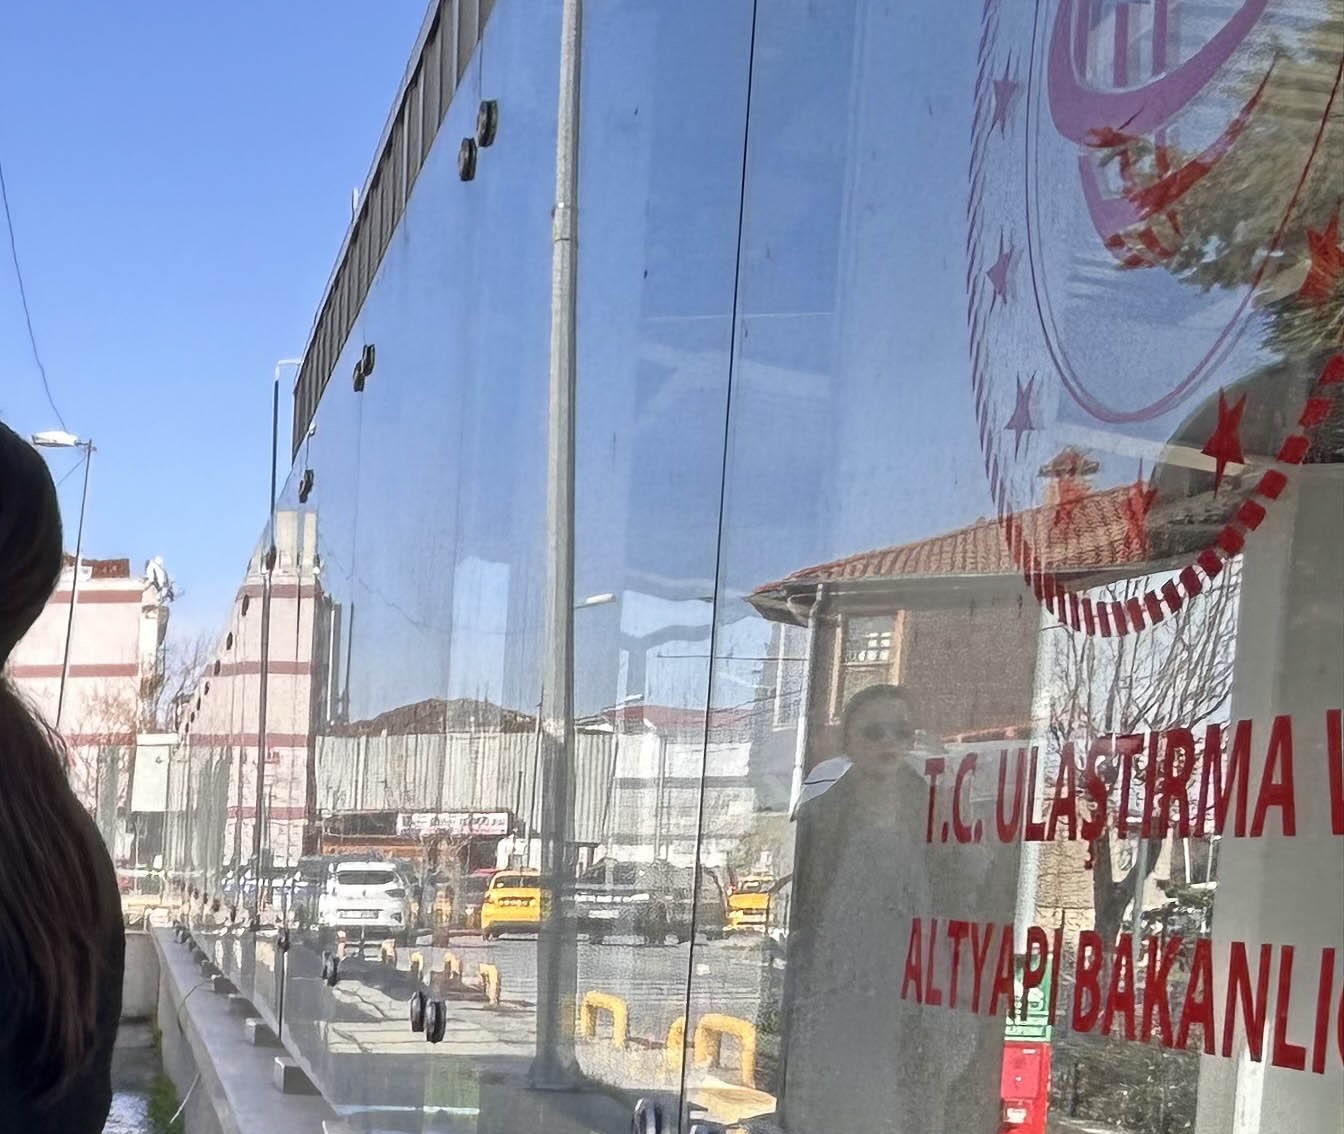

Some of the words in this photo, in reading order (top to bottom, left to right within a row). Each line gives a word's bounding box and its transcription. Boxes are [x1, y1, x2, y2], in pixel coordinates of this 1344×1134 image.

[925, 752, 983, 844] T.C.
[996, 714, 1297, 870] ULAŞTIRMA
[901, 917, 1062, 1026] ALTYAPI
[1072, 929, 1344, 1075] BAKANLI
